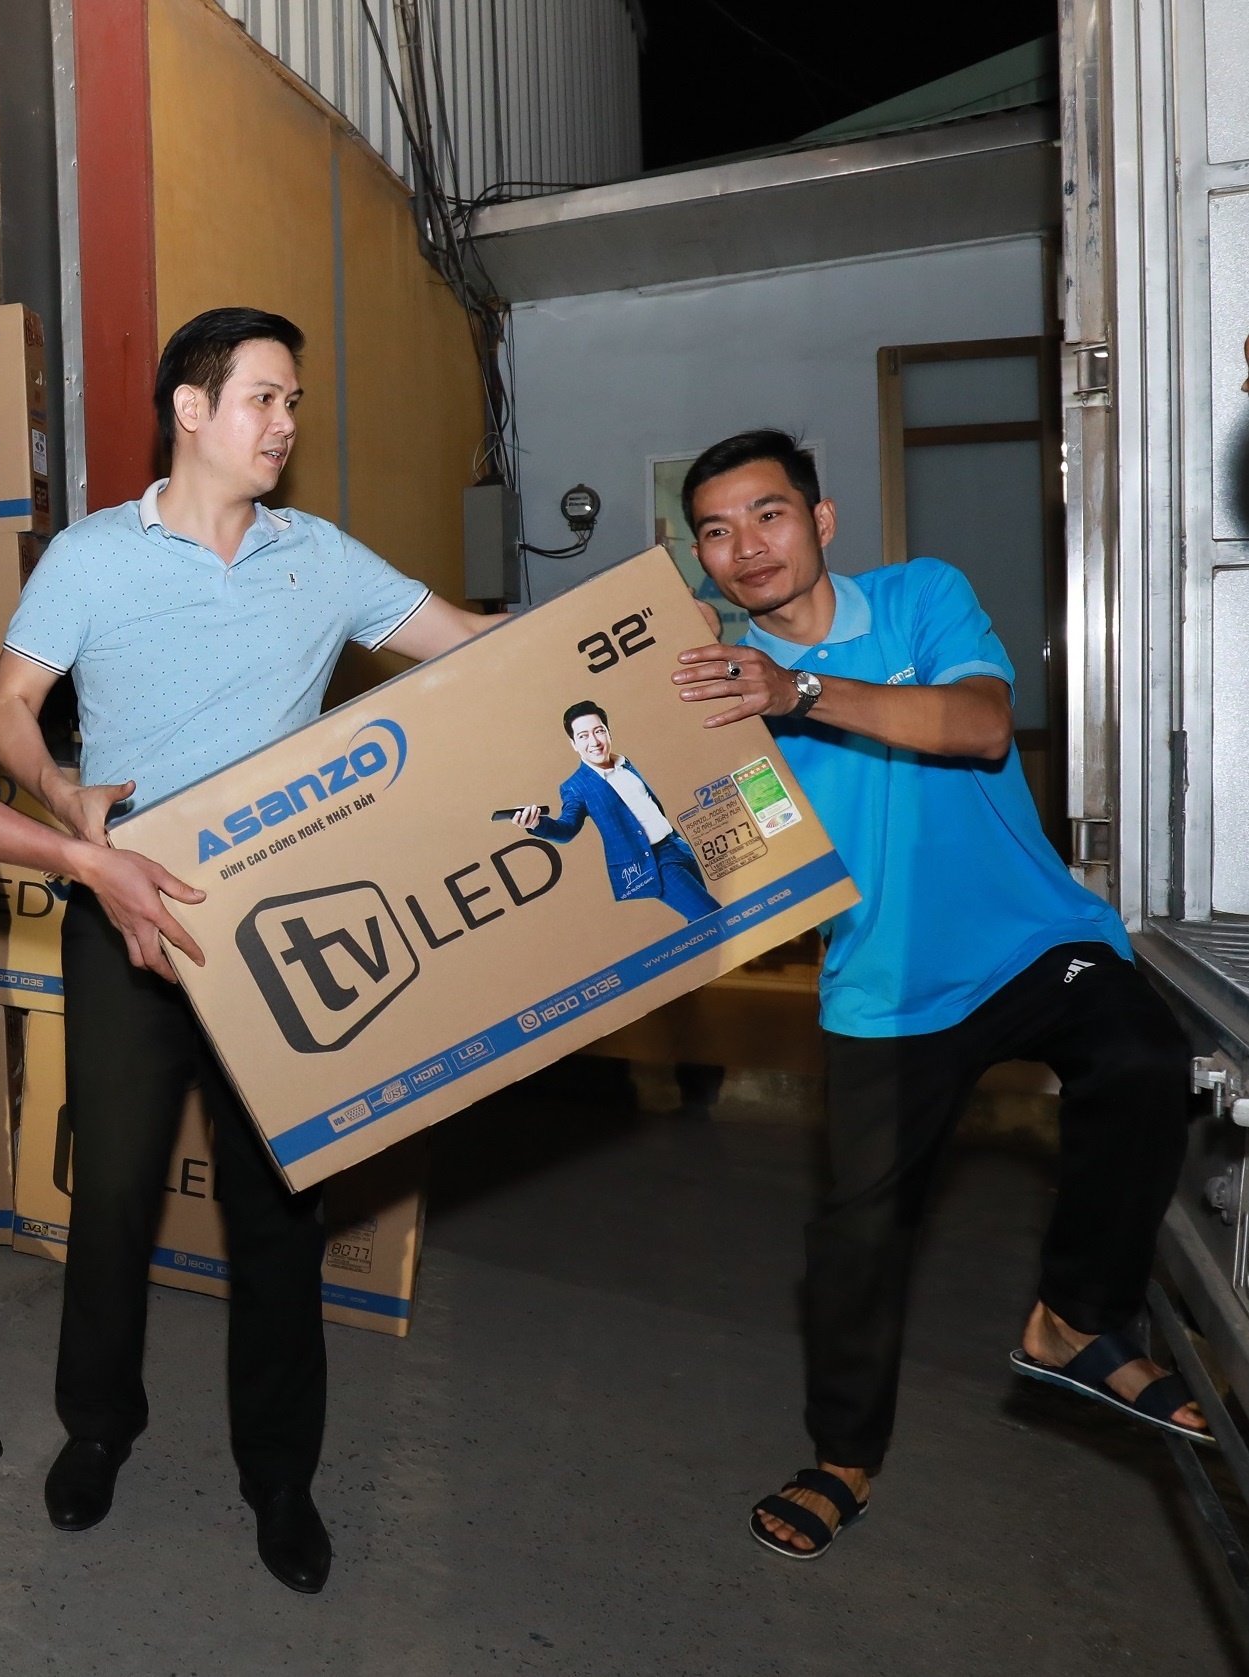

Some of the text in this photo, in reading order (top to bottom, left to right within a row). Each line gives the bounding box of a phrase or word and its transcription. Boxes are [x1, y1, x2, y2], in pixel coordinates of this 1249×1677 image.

[700, 778, 729, 807] 2 NĂM
[220, 792, 376, 880] ĐỈNH CAO CÔNG NGHỆ NHẬT BẢN
[702, 821, 752, 861] 8077
[726, 914, 741, 927] ISO
[767, 888, 792, 905] 2008
[280, 838, 563, 1012] tv LED
[642, 927, 718, 969] WWW.ASANZO.VN
[20, 976, 44, 988] 1035
[539, 996, 580, 1022] 1800
[581, 974, 621, 1001] 1035
[458, 1042, 484, 1060] LED
[413, 1063, 444, 1084] HDMI
[384, 1085, 408, 1102] USB
[332, 1242, 369, 1259] 8077
